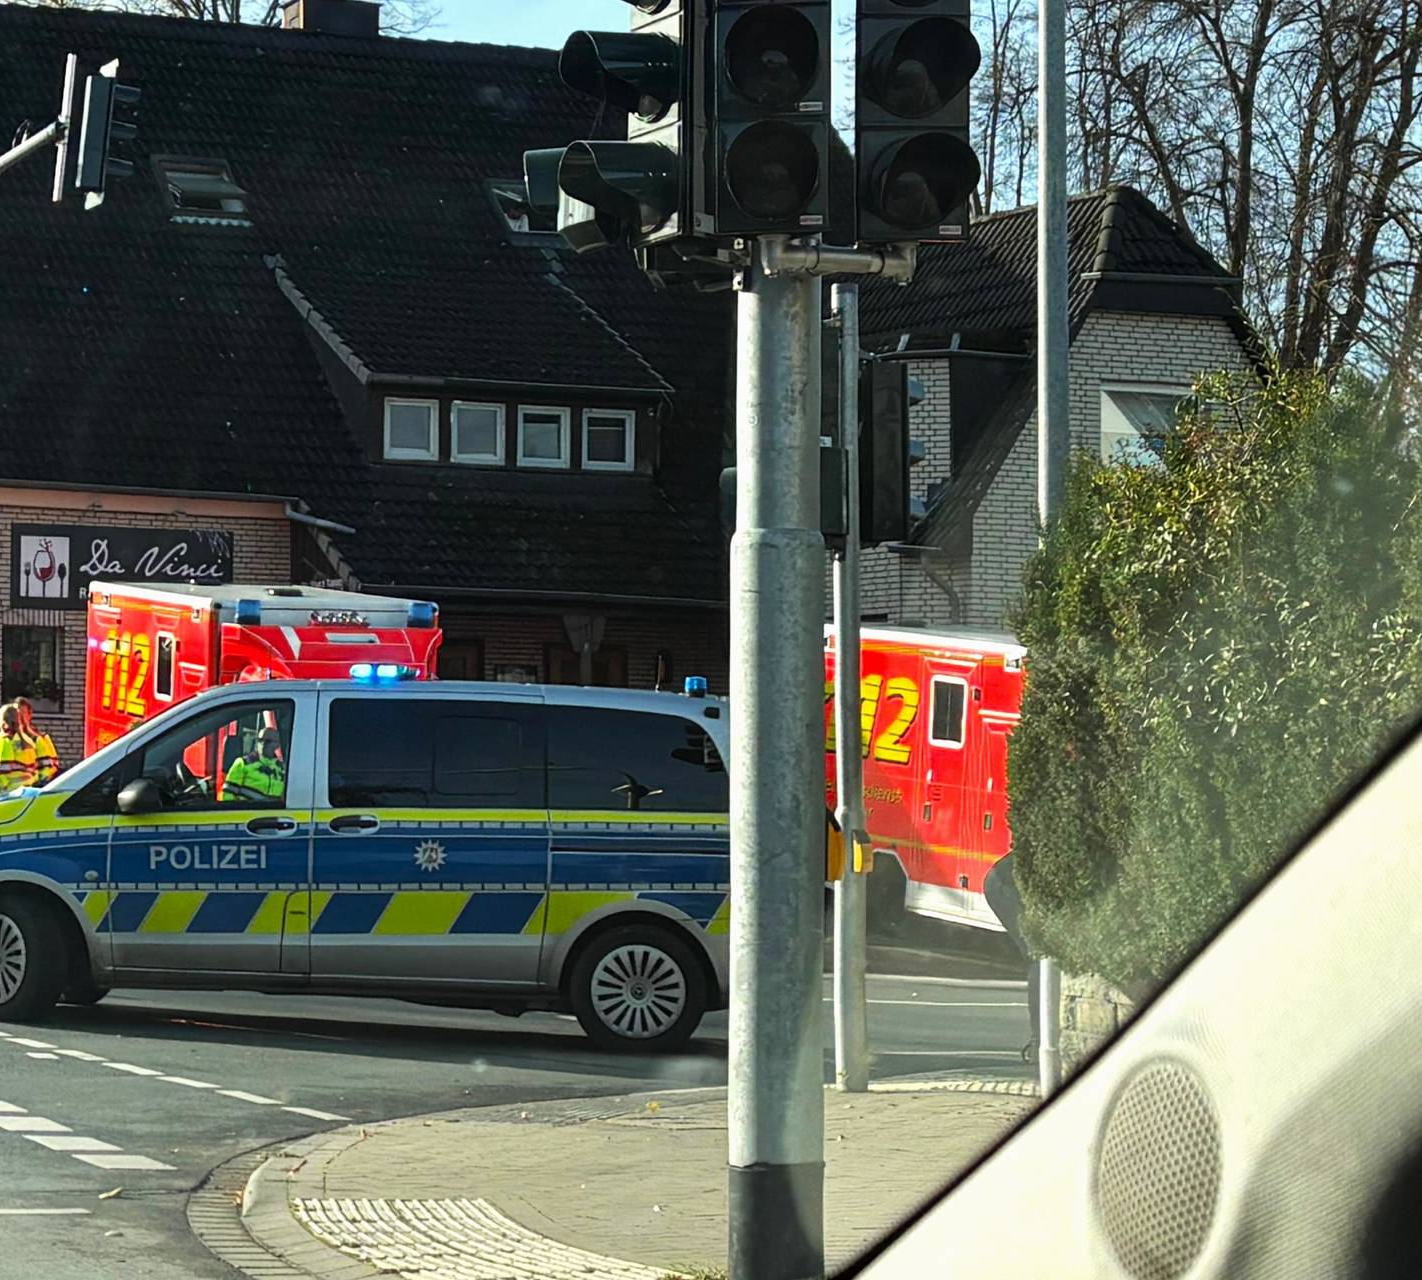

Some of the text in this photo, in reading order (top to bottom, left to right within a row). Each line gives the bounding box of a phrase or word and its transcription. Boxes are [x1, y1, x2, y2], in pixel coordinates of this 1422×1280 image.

[80, 539, 223, 577] Da Vinci
[101, 628, 150, 716] 112
[824, 674, 920, 766] 12
[149, 844, 268, 870] POLIZEI
